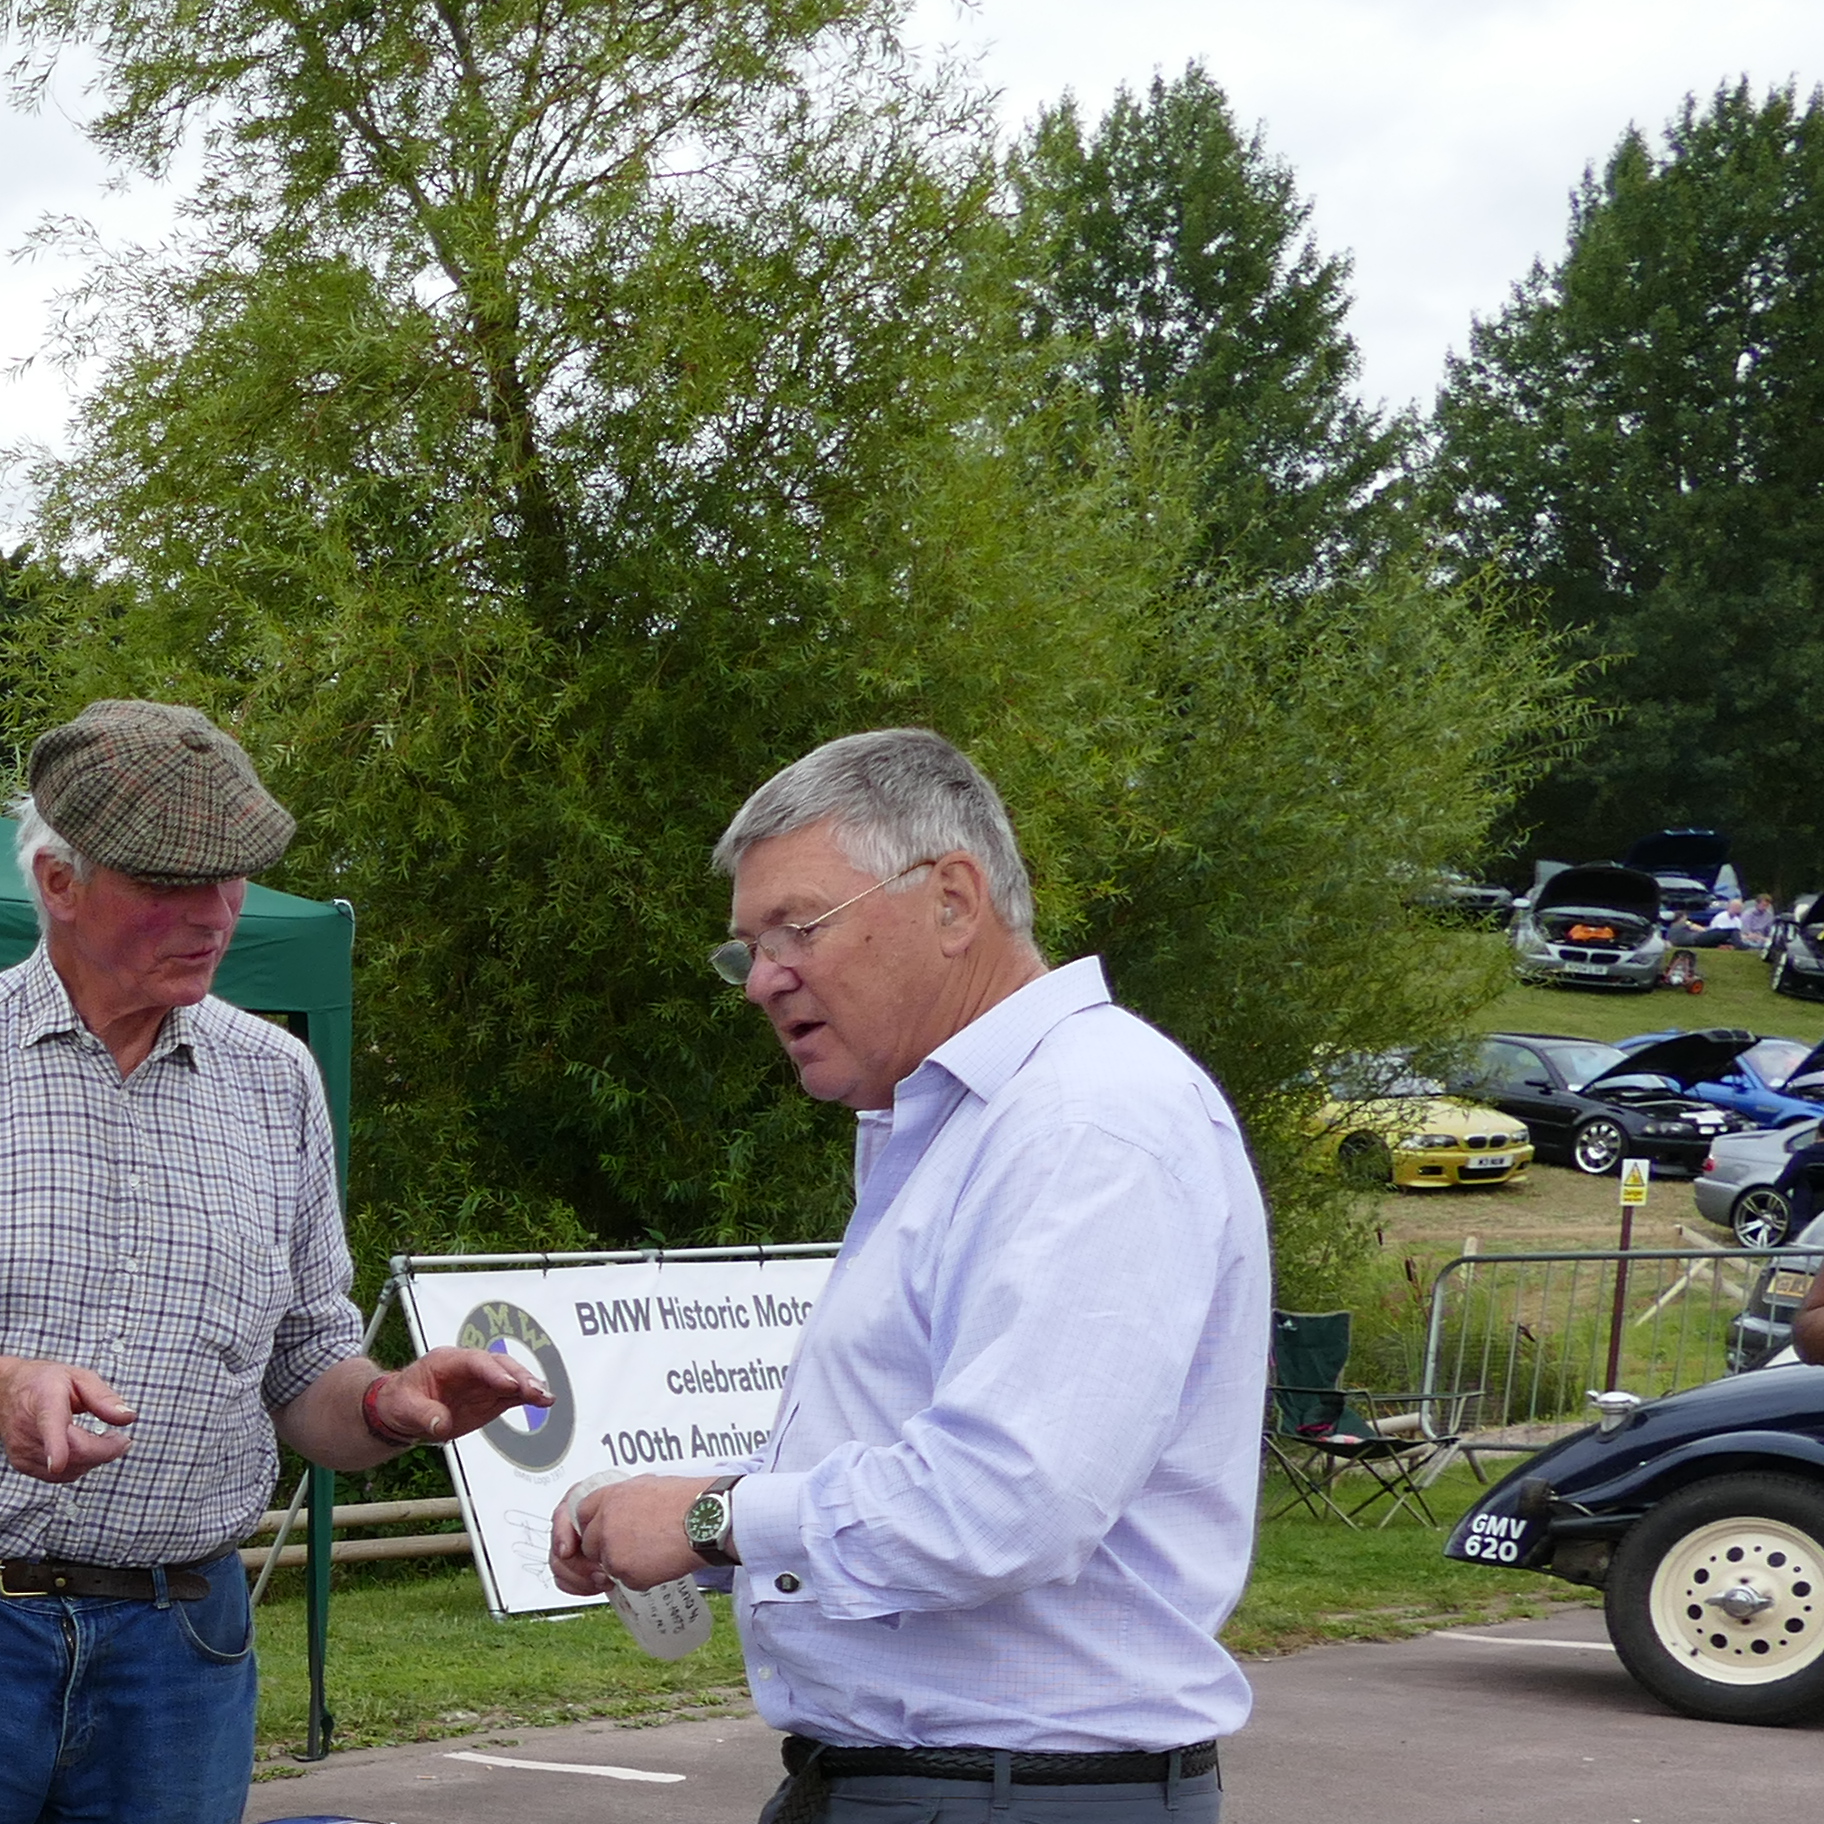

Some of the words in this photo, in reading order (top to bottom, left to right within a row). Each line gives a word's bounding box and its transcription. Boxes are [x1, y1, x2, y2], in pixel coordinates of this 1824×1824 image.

[575, 1297, 651, 1336] BMW
[656, 1295, 750, 1330] Historic
[601, 1427, 683, 1466] 100th
[1472, 1513, 1527, 1539] GMV
[1465, 1535, 1518, 1562] 620
